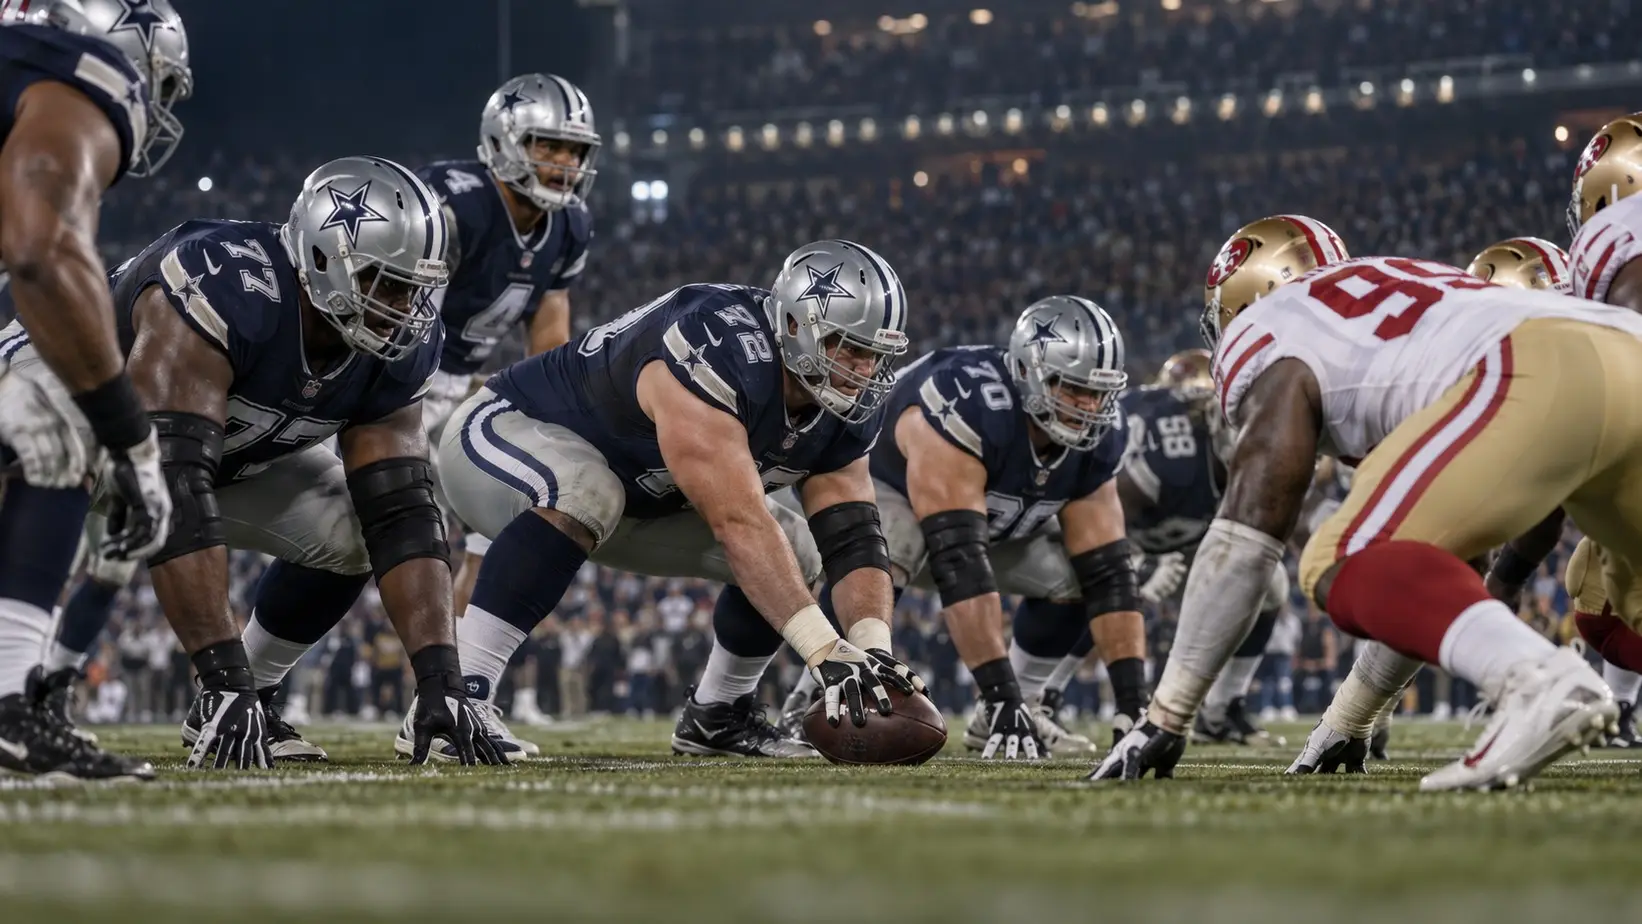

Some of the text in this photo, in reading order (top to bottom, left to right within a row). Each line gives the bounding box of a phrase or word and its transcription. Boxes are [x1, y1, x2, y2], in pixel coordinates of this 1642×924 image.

[443, 169, 484, 195] 4
[220, 239, 281, 303] 77
[461, 282, 535, 362] 4
[714, 304, 774, 364] 72
[962, 360, 1014, 411] 70
